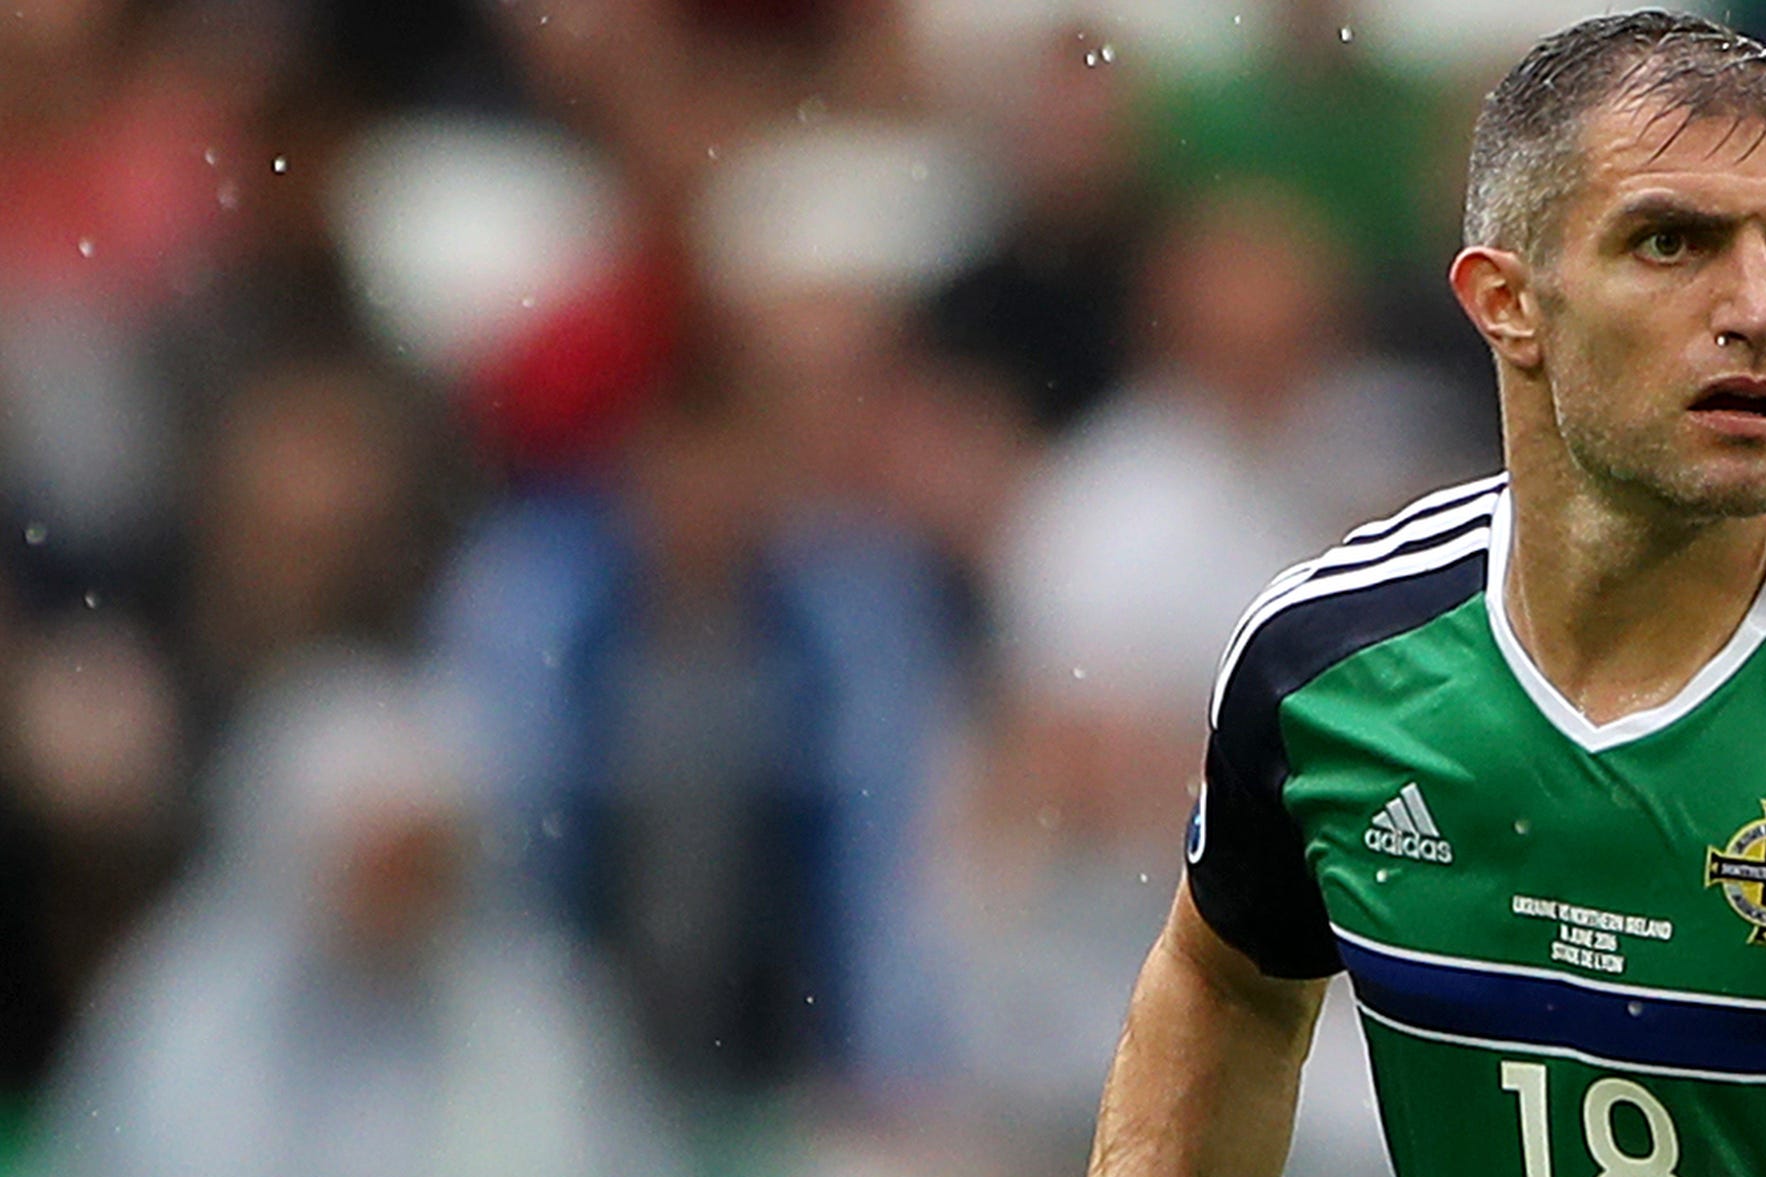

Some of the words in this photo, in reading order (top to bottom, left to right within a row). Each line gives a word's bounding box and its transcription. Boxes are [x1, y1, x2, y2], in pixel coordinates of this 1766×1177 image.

[1364, 828, 1453, 863] adidas
[1571, 906, 1624, 933] NORTHERN
[1625, 915, 1672, 940] IRELAND
[1594, 952, 1625, 974] LYON
